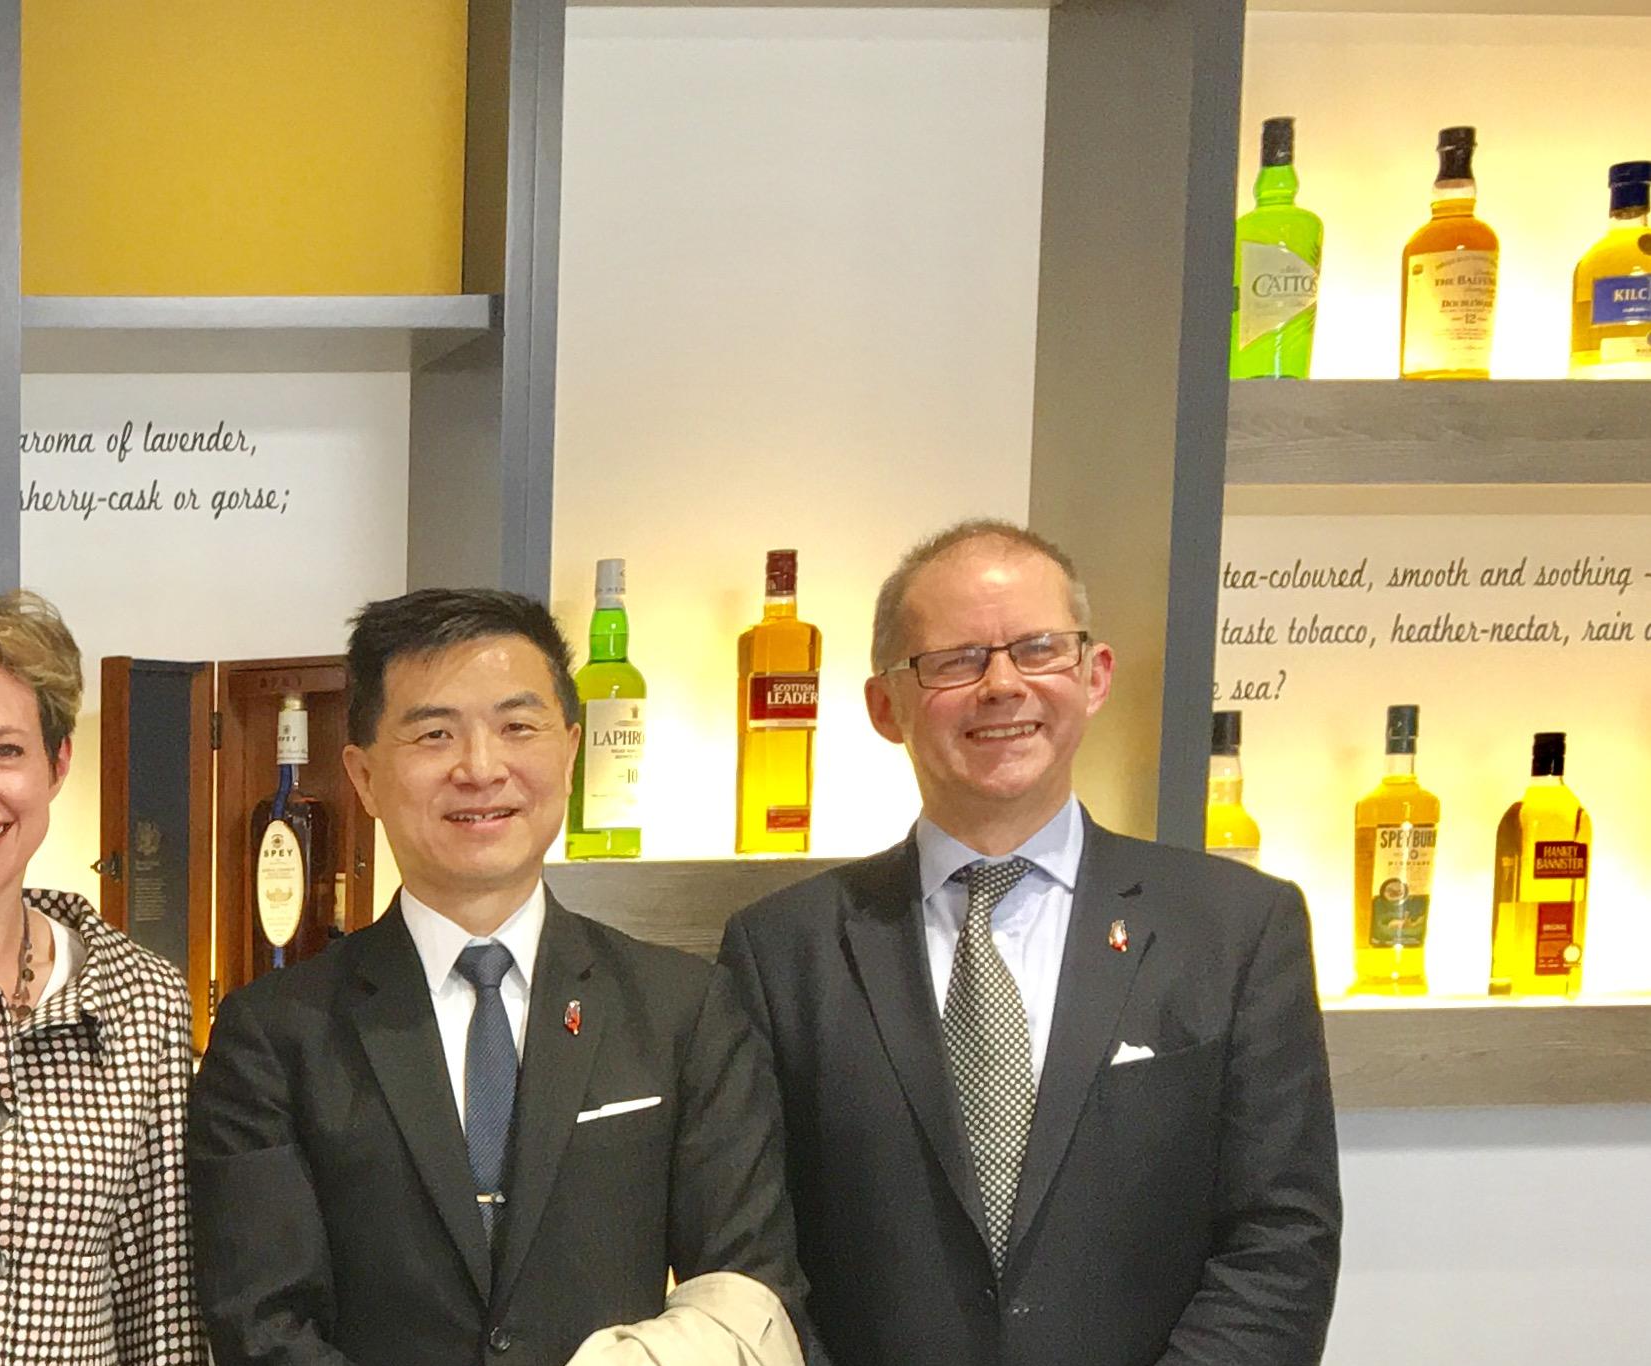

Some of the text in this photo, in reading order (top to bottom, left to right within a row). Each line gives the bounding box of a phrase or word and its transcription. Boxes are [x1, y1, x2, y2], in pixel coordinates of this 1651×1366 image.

[20, 420, 256, 462] aroma of lavender,
[174, 488, 200, 510] or
[211, 488, 290, 520] gorse;
[1223, 555, 1634, 595] tea-coloured, smooth and soothing
[1221, 617, 1278, 645] taste
[1288, 613, 1376, 649] tobacco,
[1390, 612, 1570, 647] heather-nectar,
[1581, 610, 1636, 641] rain
[773, 683, 815, 692] SCOTTISH
[1229, 669, 1287, 700] sea?
[767, 691, 818, 705] LEADER
[263, 849, 294, 858] SPEY
[1543, 845, 1578, 857] HANKEY
[1536, 857, 1584, 870] BANNISTER
